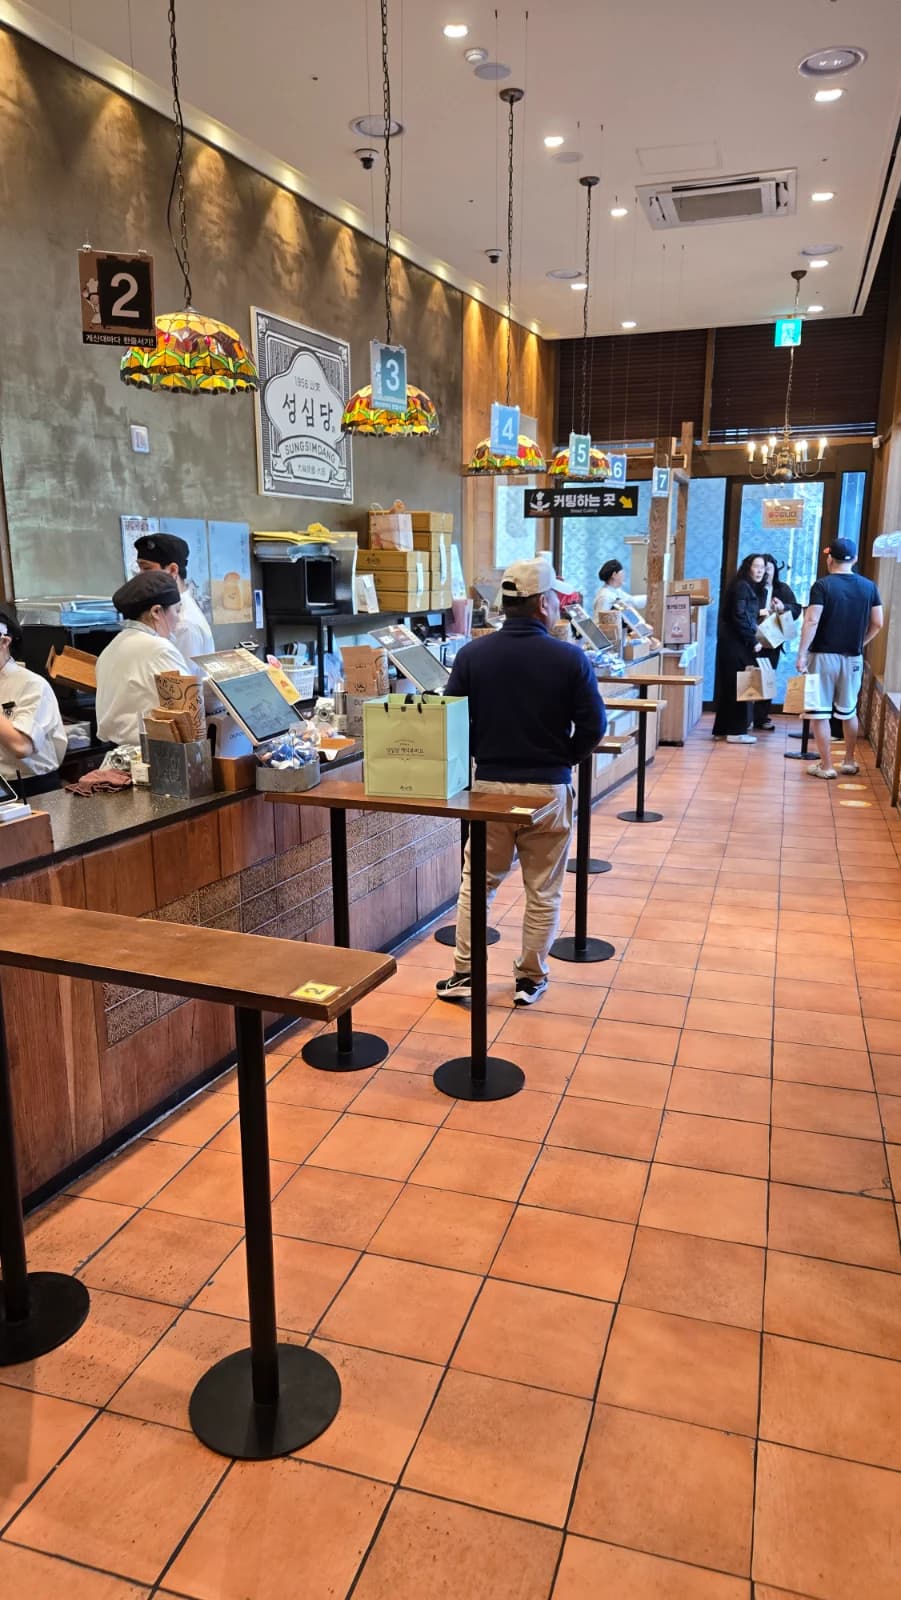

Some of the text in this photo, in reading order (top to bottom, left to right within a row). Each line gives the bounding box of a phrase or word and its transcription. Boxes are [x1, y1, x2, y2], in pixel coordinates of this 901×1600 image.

[111, 272, 140, 318] 2
[86, 334, 121, 344] 계산대마다
[386, 358, 400, 391] 3
[282, 393, 334, 431] 성심당
[501, 416, 515, 441] 4
[284, 441, 336, 463] SUNGSIMDANG
[576, 443, 587, 463] 5
[612, 461, 623, 479] 6
[658, 473, 668, 489] 7
[553, 493, 616, 507] 커팅하는 곳
[304, 987, 327, 995] 2
